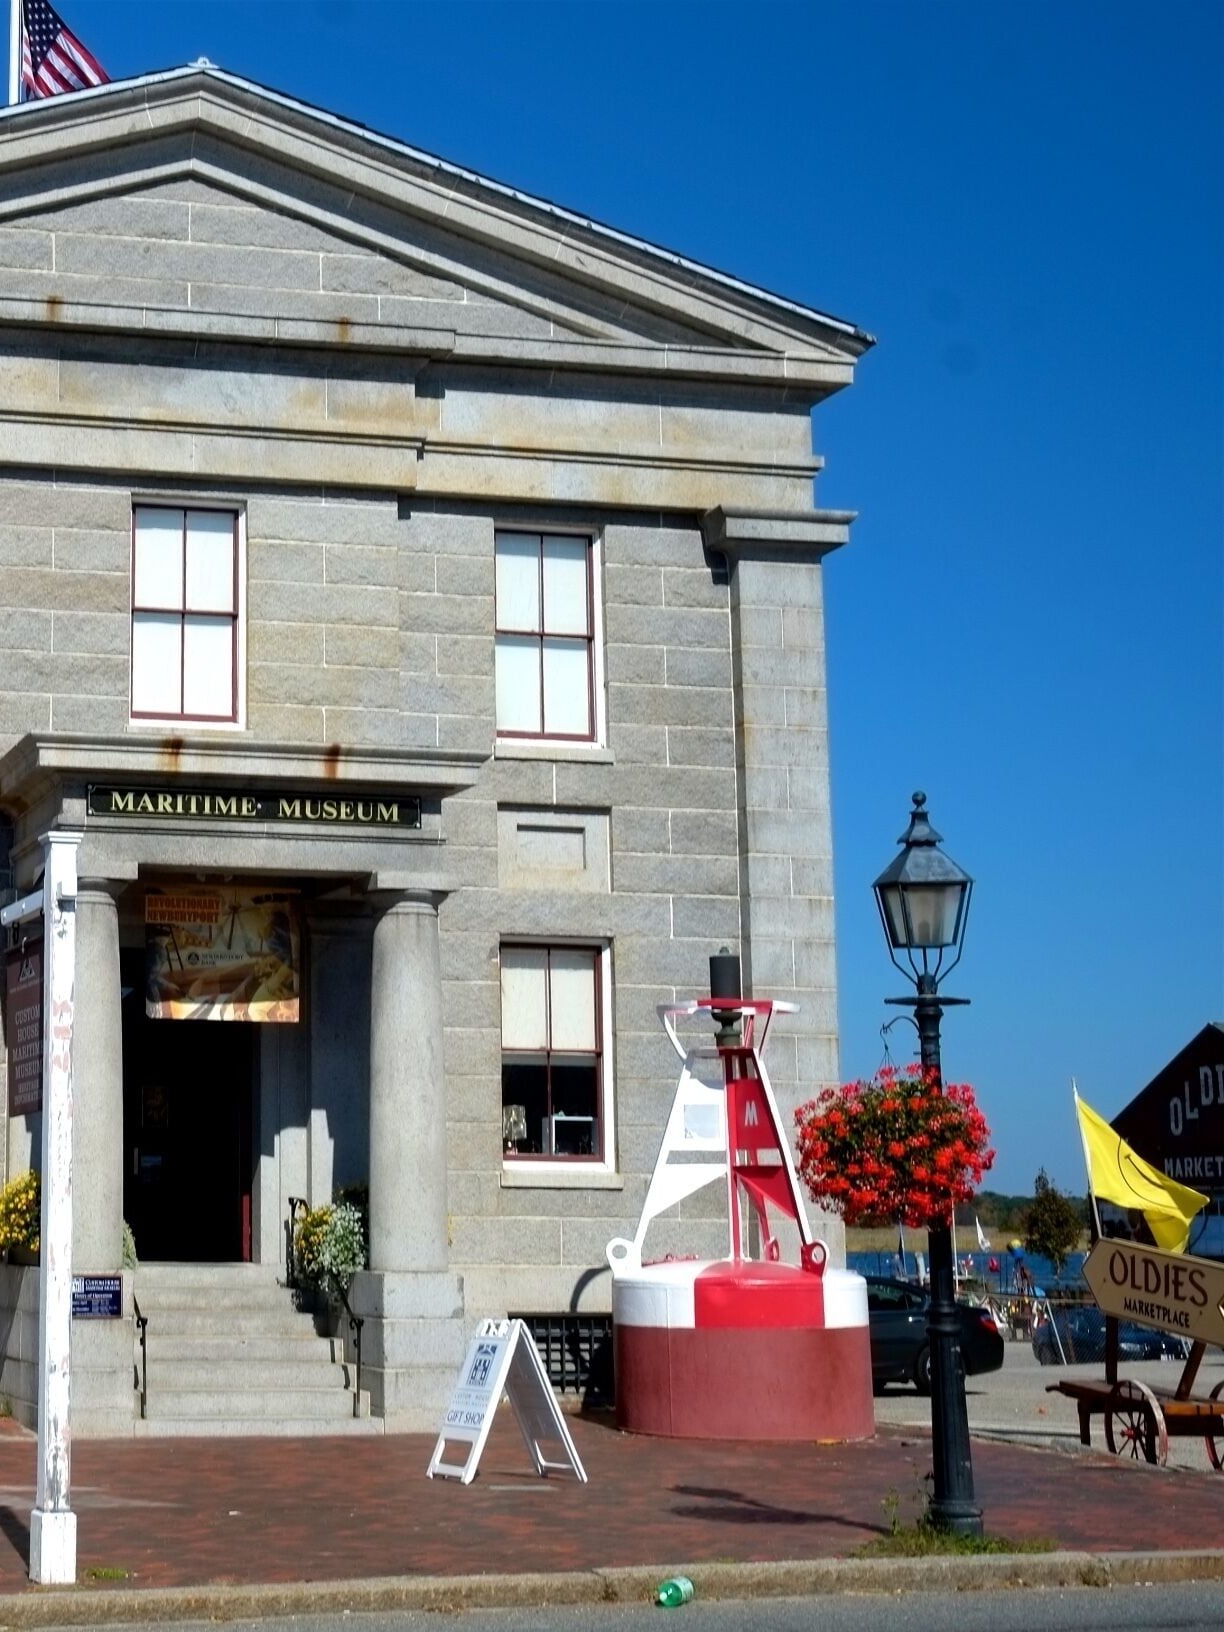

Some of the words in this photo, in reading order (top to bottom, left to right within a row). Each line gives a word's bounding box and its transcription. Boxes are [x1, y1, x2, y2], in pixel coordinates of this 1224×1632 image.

[110, 791, 258, 817] MARITIME
[278, 798, 400, 823] MUSEUM
[147, 895, 221, 910] REVOLUTIONARY
[146, 910, 219, 924] NEWBURYPORT
[15, 1003, 41, 1026] CUSTOM
[17, 1022, 39, 1042] HOUSE
[15, 1059, 42, 1079] MUSEUM
[744, 1100, 758, 1127] M
[1108, 1248, 1209, 1308] OLDIES
[1123, 1296, 1190, 1329] MARKETPLACE
[447, 1409, 464, 1423] GIFT
